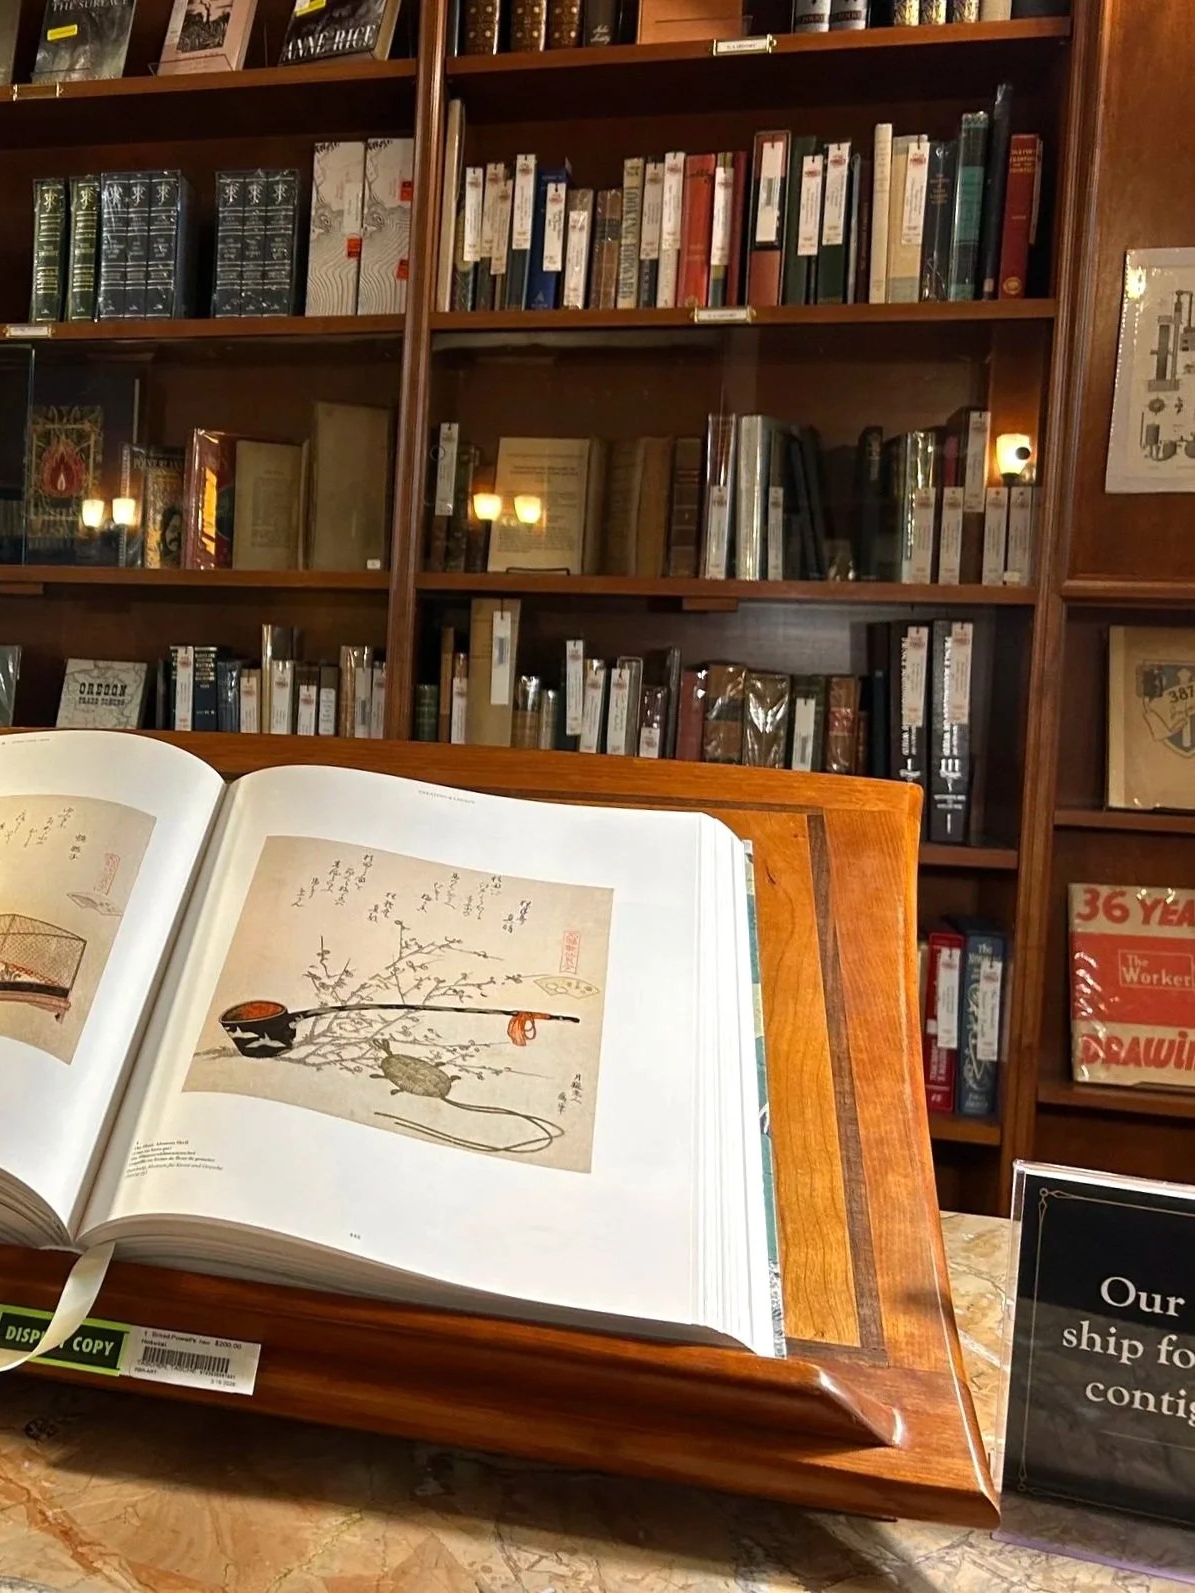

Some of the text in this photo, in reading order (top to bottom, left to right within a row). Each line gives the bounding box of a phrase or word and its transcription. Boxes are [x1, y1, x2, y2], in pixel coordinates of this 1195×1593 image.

[285, 24, 377, 61] ANNE RICE
[79, 682, 127, 697] OREGON
[1076, 887, 1130, 924] 36
[977, 943, 993, 954] The
[1126, 953, 1149, 968] The
[1121, 967, 1191, 986] Worker
[1100, 1276, 1187, 1317] Our
[72, 1336, 114, 1356] COPY
[214, 1340, 242, 1350] $200.00
[1061, 1319, 1145, 1366] ship
